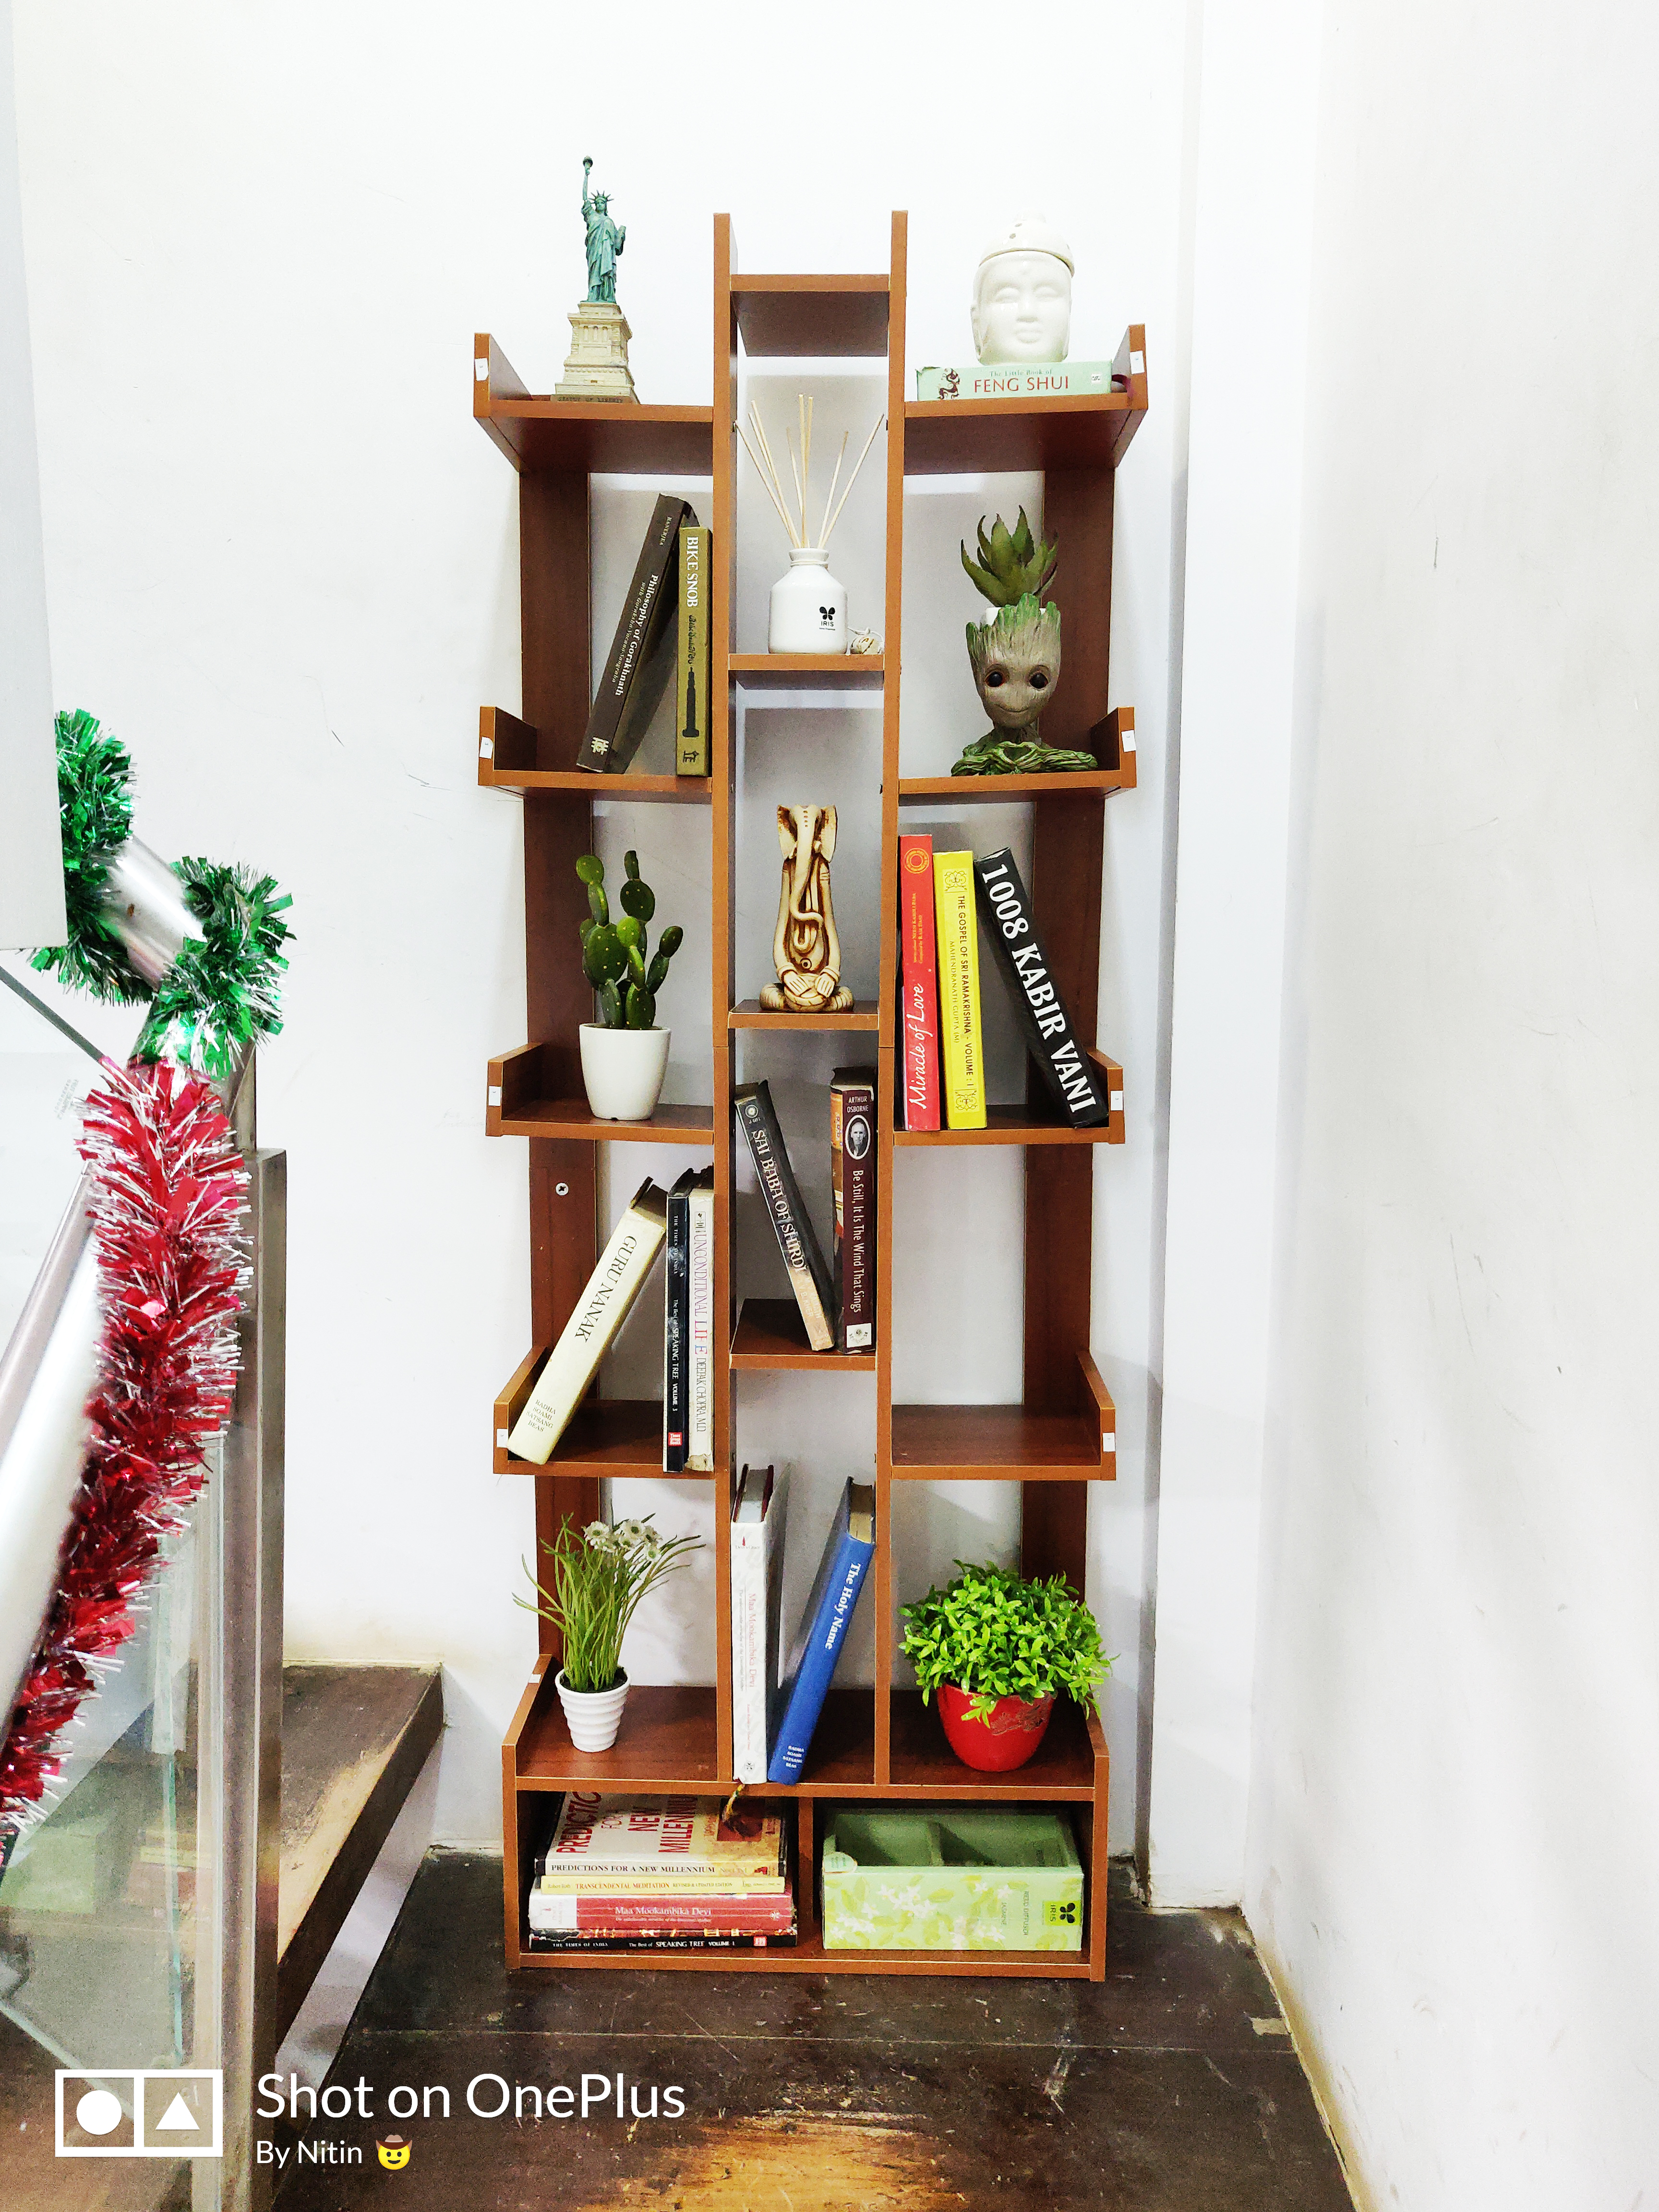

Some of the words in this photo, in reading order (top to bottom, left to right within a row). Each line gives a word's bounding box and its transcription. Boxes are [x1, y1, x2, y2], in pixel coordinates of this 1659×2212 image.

[974, 378, 1019, 393] FENG
[1027, 376, 1068, 391] SHUI
[686, 537, 699, 570] BIKE
[635, 574, 659, 627] Philosophy
[686, 573, 698, 607] SNOB
[632, 628, 640, 641] of
[615, 641, 637, 696] Gorakhnath
[960, 949, 968, 957] OF
[950, 941, 959, 1002] MAHENDRANATH
[982, 864, 1029, 939] 1008
[1011, 942, 1066, 1040] KABIR
[1051, 1039, 1096, 1113] VANI
[906, 983, 924, 1022] Love
[962, 975, 971, 1034] RAMAKRISHNA
[908, 1023, 933, 1040] of
[965, 1043, 974, 1075] VOLUME
[908, 1043, 927, 1109] Miracle
[847, 1105, 869, 1113] OSBORNE
[751, 1130, 770, 1155] SAI
[760, 1156, 784, 1200] BABA
[853, 1170, 864, 1181] Be
[852, 1183, 865, 1203] Still,
[775, 1200, 790, 1220] OF
[853, 1225, 865, 1240] The
[607, 1236, 637, 1285] GURU
[780, 1224, 808, 1274] SHIRDI
[853, 1243, 865, 1266] Wind
[694, 1234, 708, 1317] UNCONDITIONAL
[853, 1269, 865, 1288] That
[574, 1282, 614, 1343] NANAK
[850, 1290, 865, 1313] Sings
[694, 1320, 708, 1355] LIFE
[696, 1358, 707, 1384] DEEPAK
[526, 1410, 553, 1429] SATSANG
[533, 1407, 553, 1420] SOAMI
[535, 1399, 556, 1415] RADHA
[528, 1420, 544, 1432] BEAS
[846, 1563, 861, 1585] The
[748, 1593, 757, 1611] Maa
[834, 1586, 853, 1616] Holy
[748, 1613, 757, 1666] Mookambika
[825, 1616, 843, 1650] Name
[627, 1806, 662, 1831] NEW
[636, 1907, 689, 1915] Mookambika
[692, 1907, 711, 1915] Devi
